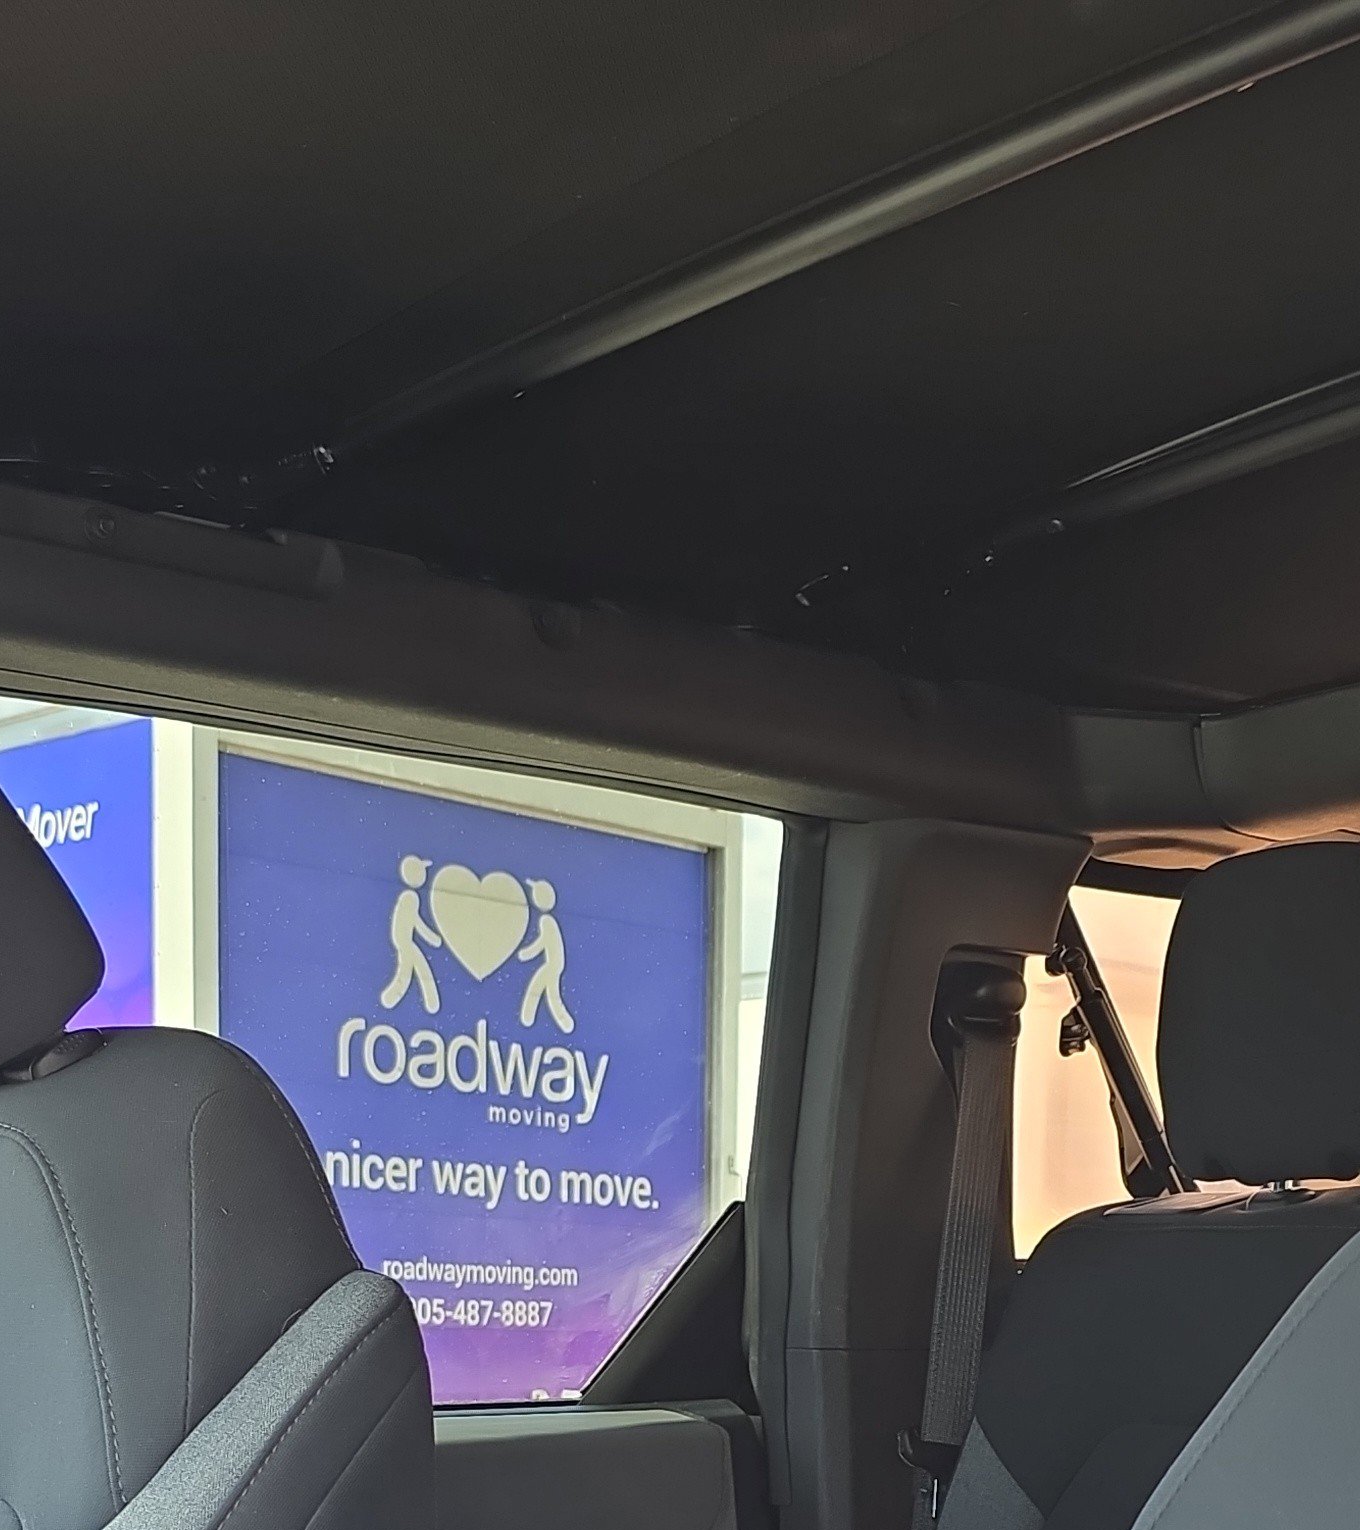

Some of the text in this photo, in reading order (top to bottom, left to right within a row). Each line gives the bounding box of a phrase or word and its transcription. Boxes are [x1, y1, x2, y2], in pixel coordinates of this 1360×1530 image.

[337, 1017, 609, 1125] roadway
[488, 1103, 571, 1134] moving
[325, 1138, 660, 1210] nicer way to move.
[383, 1254, 578, 1291] roadwaymoving.com
[412, 1298, 553, 1327] 05-487-8887
